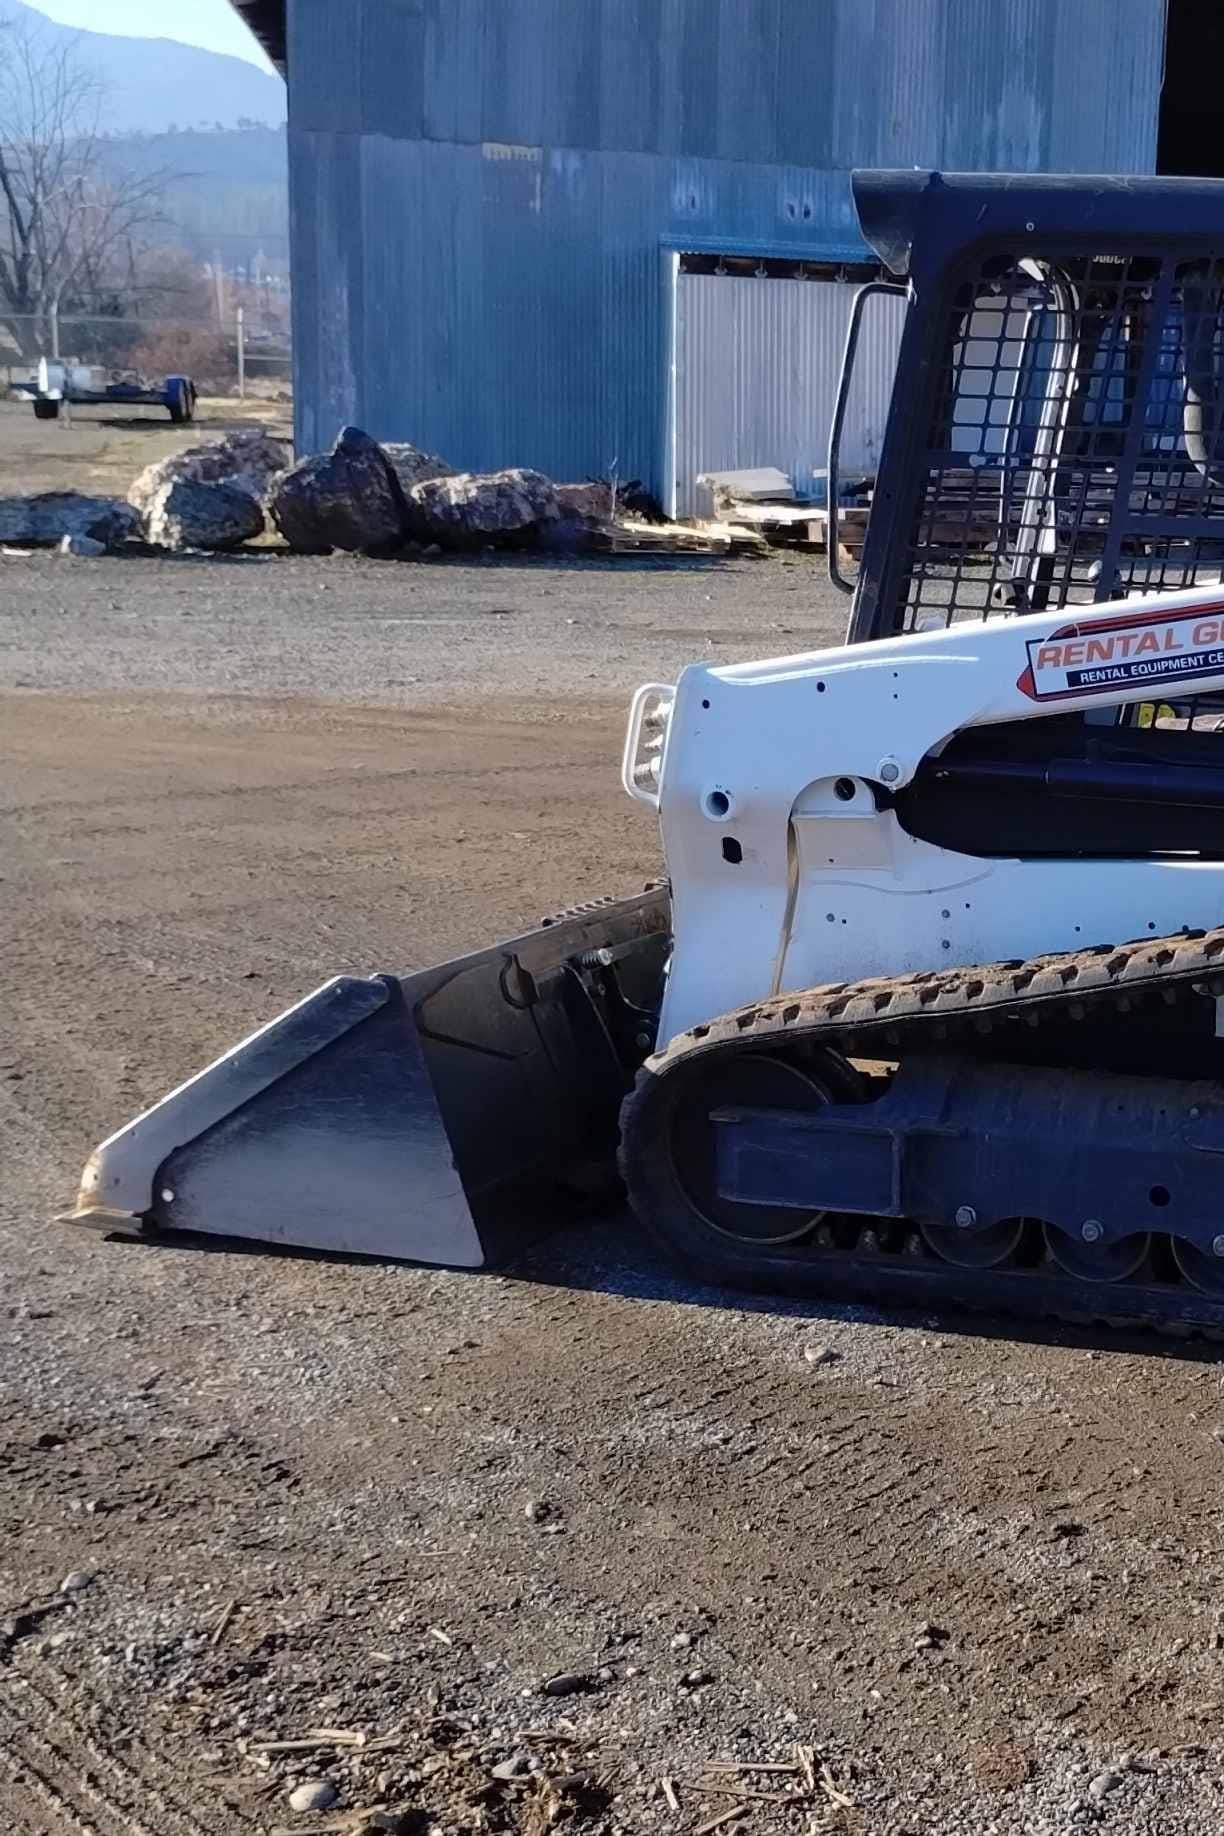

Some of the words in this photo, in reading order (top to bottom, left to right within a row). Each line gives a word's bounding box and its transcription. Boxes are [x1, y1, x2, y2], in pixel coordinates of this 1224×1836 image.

[1037, 628, 1184, 670] RENTAL
[1080, 667, 1128, 684] RENTAL
[1131, 656, 1205, 676] EQUIPMENT
